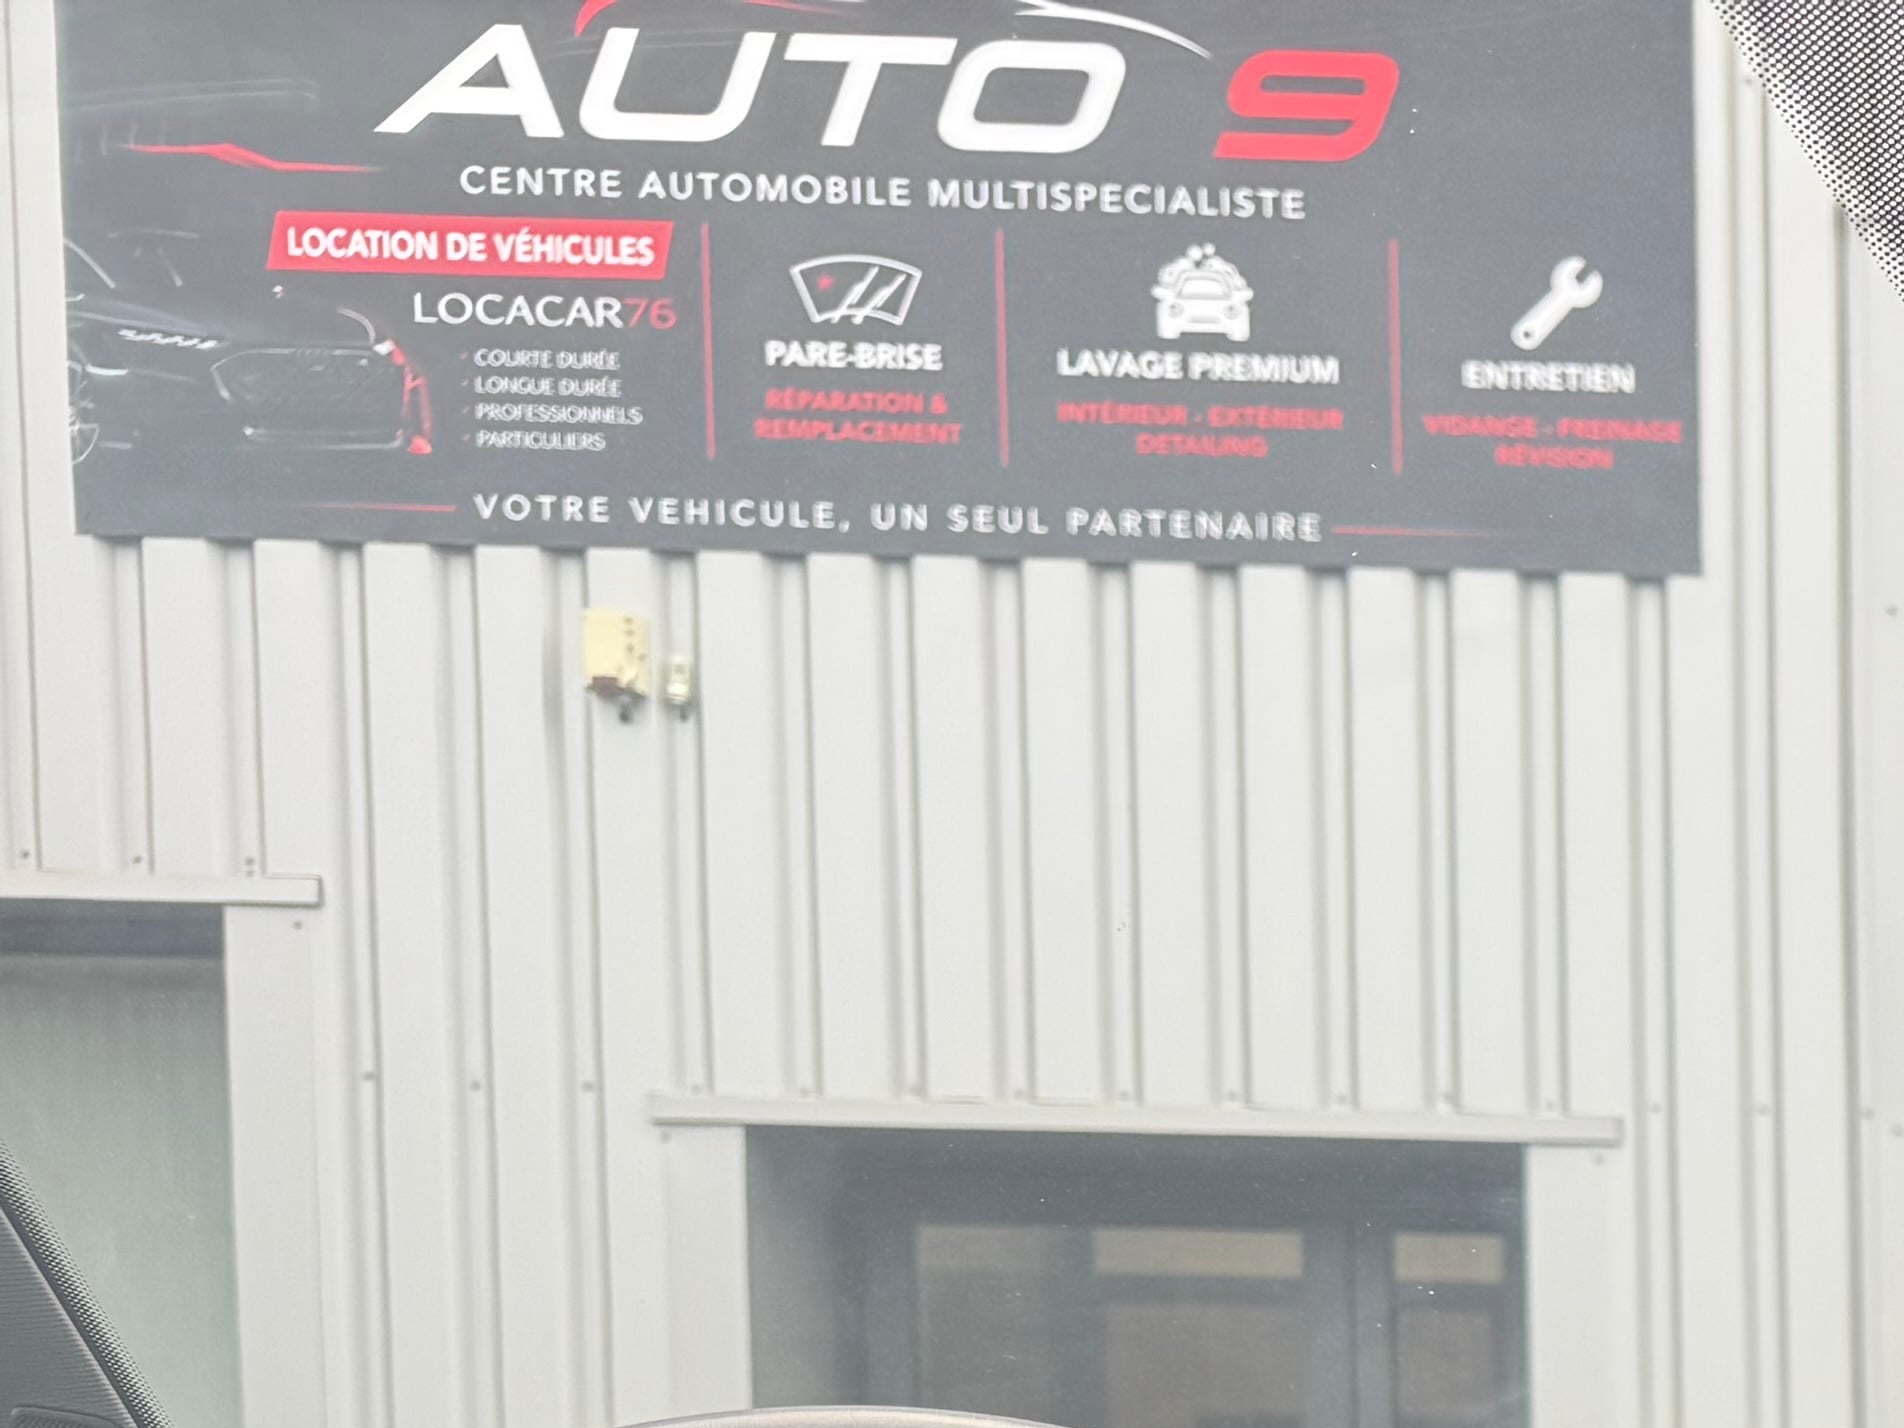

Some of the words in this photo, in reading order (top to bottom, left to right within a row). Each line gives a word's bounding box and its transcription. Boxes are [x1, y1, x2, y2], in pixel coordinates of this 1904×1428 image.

[373, 23, 1126, 153] AUTO
[1212, 49, 1399, 162] 9
[460, 165, 622, 197] CENTRE
[639, 171, 911, 206] AUTOMOBILE
[927, 179, 1306, 220] MULTISPECIALISTE
[287, 226, 437, 261] LOCATION
[446, 231, 487, 262] DE
[494, 227, 655, 267] VÉHICULES
[413, 292, 677, 330] LOCACAR76
[474, 347, 553, 369] COURTE
[556, 348, 621, 370] DURÉE
[764, 340, 943, 371] PARE-BRISE
[1056, 346, 1184, 380] LAVAGE
[1187, 351, 1340, 384] PREMIUM
[474, 375, 555, 396] LONGUE
[558, 375, 623, 398] DURÉE
[1461, 359, 1636, 393] ENTRETIEN
[474, 402, 644, 425] PROFESSIONNELS
[764, 386, 924, 416] RÉPARATION
[475, 429, 606, 451] PARTICULIERS
[753, 417, 963, 445] REMPLACEMENT
[474, 494, 610, 523] VOTRE
[629, 497, 850, 534] VEHICULE,
[870, 503, 928, 532] UN
[946, 504, 1049, 535] SEUL
[1065, 507, 1323, 542] PARTENAIRE
